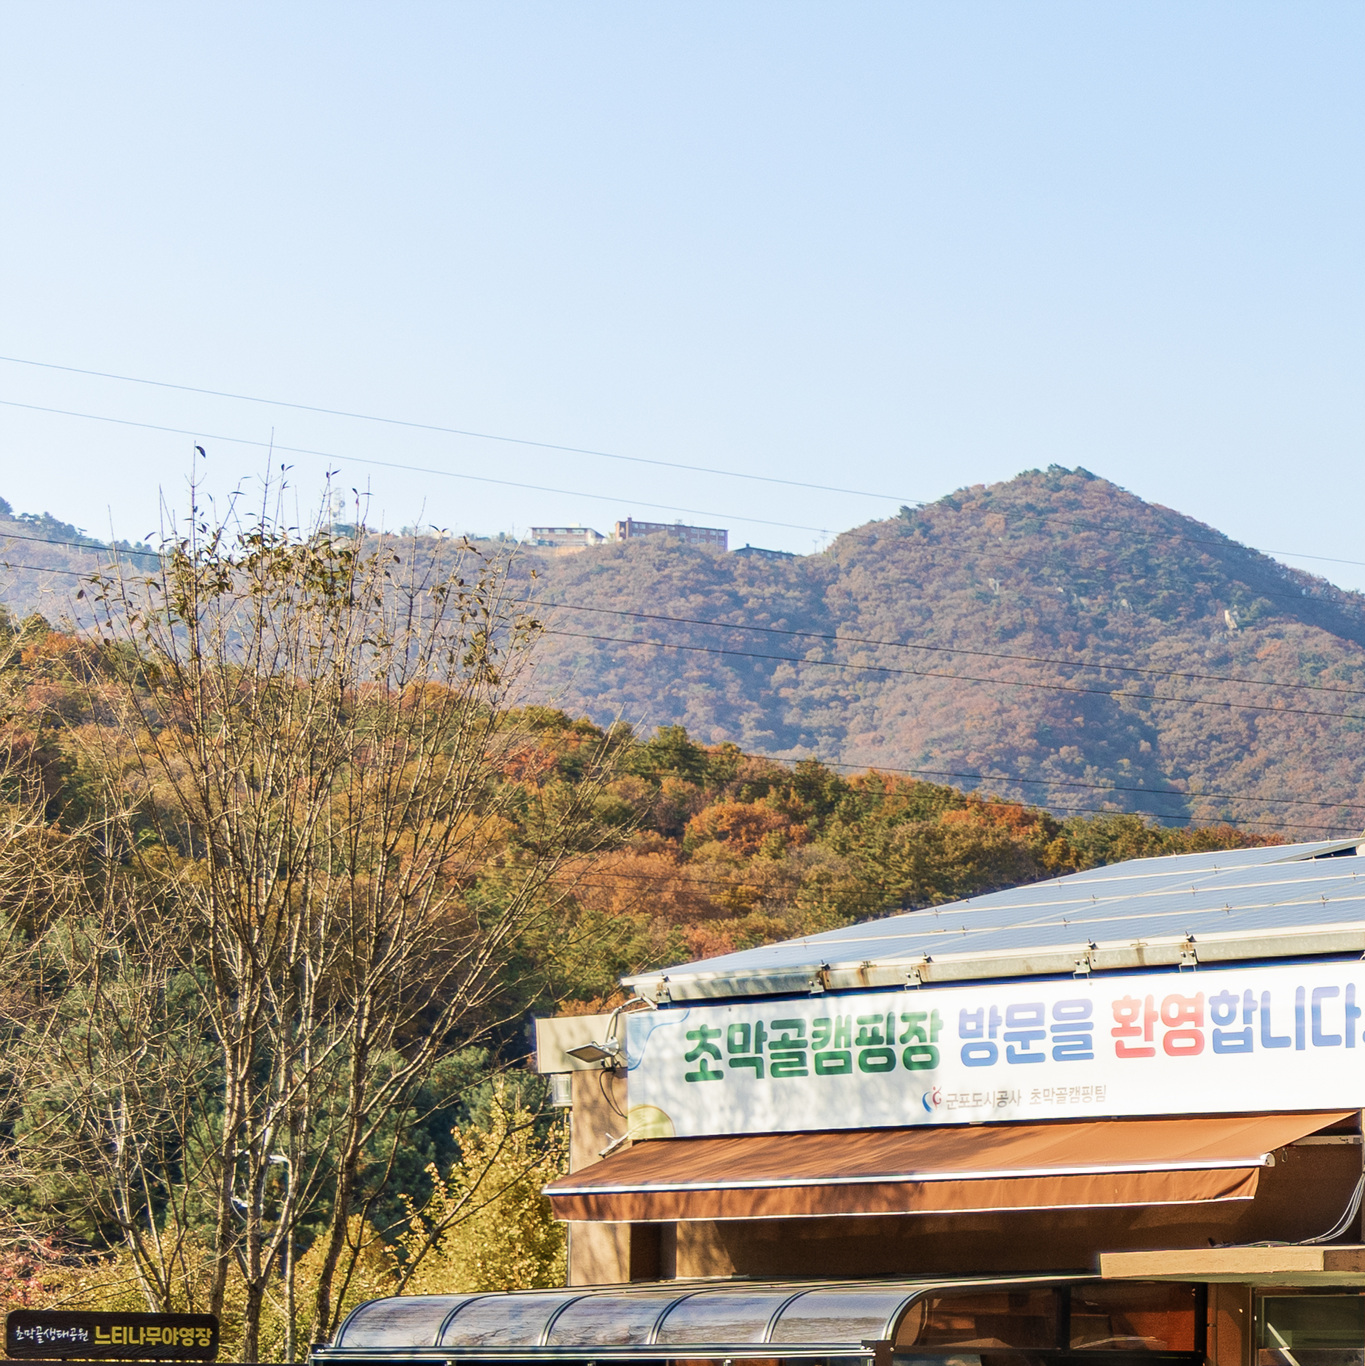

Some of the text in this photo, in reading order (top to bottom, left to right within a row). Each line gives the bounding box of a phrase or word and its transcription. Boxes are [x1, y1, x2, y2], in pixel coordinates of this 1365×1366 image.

[684, 1008, 944, 1083] 초막골캠핑장
[958, 998, 1095, 1067] 방문을
[946, 1085, 1107, 1110] 군포도시공사 초막골캠핑팀
[15, 1325, 213, 1347] 초막골생태공원 느티나무야영장
